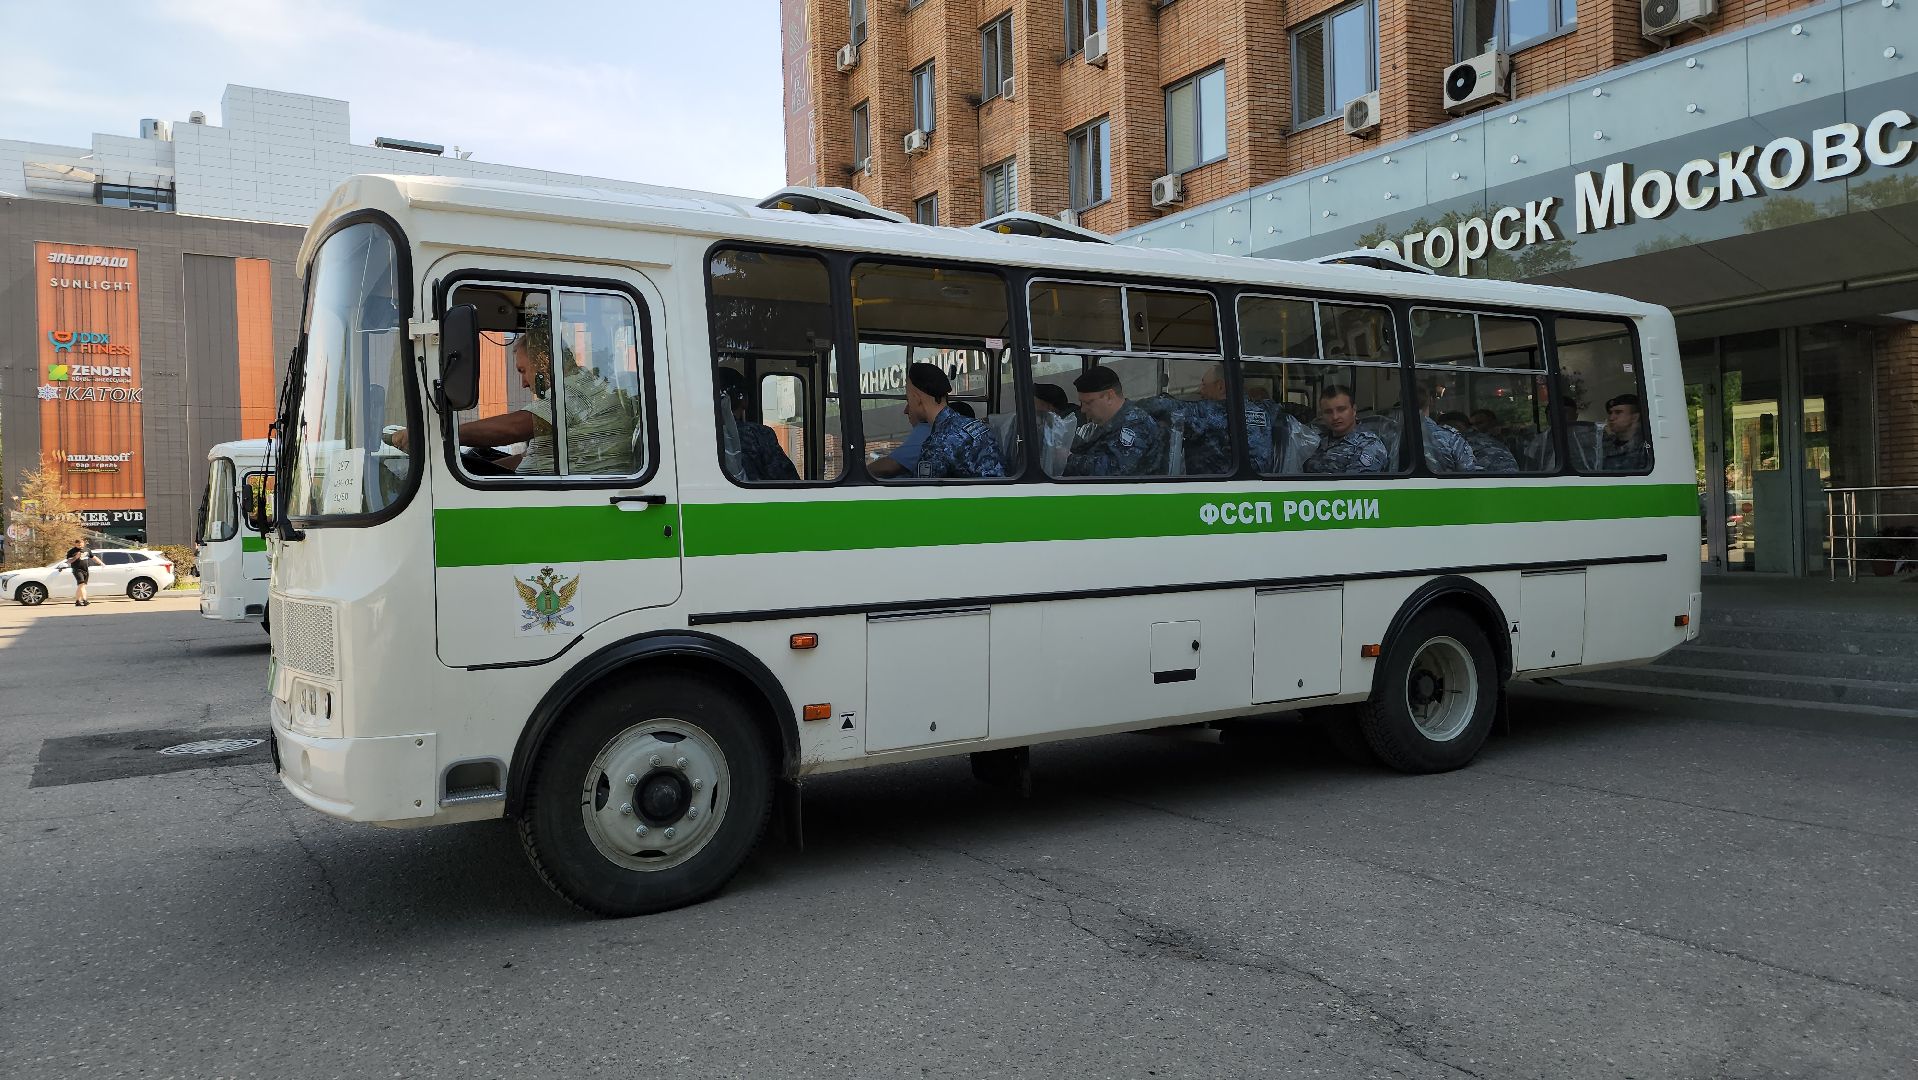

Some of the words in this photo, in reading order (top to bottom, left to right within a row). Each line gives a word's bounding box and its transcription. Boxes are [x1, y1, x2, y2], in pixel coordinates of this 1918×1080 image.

[47, 253, 128, 267] ЭЛЬДОРАДО
[50, 277, 132, 291] SUNLIGHT
[80, 332, 109, 344] DDX
[80, 343, 132, 355] FITNESS
[71, 364, 132, 377] ZENDEN
[114, 512, 143, 522] PUB
[1199, 501, 1273, 525] ФССП
[1283, 498, 1380, 522] РОССИИ
